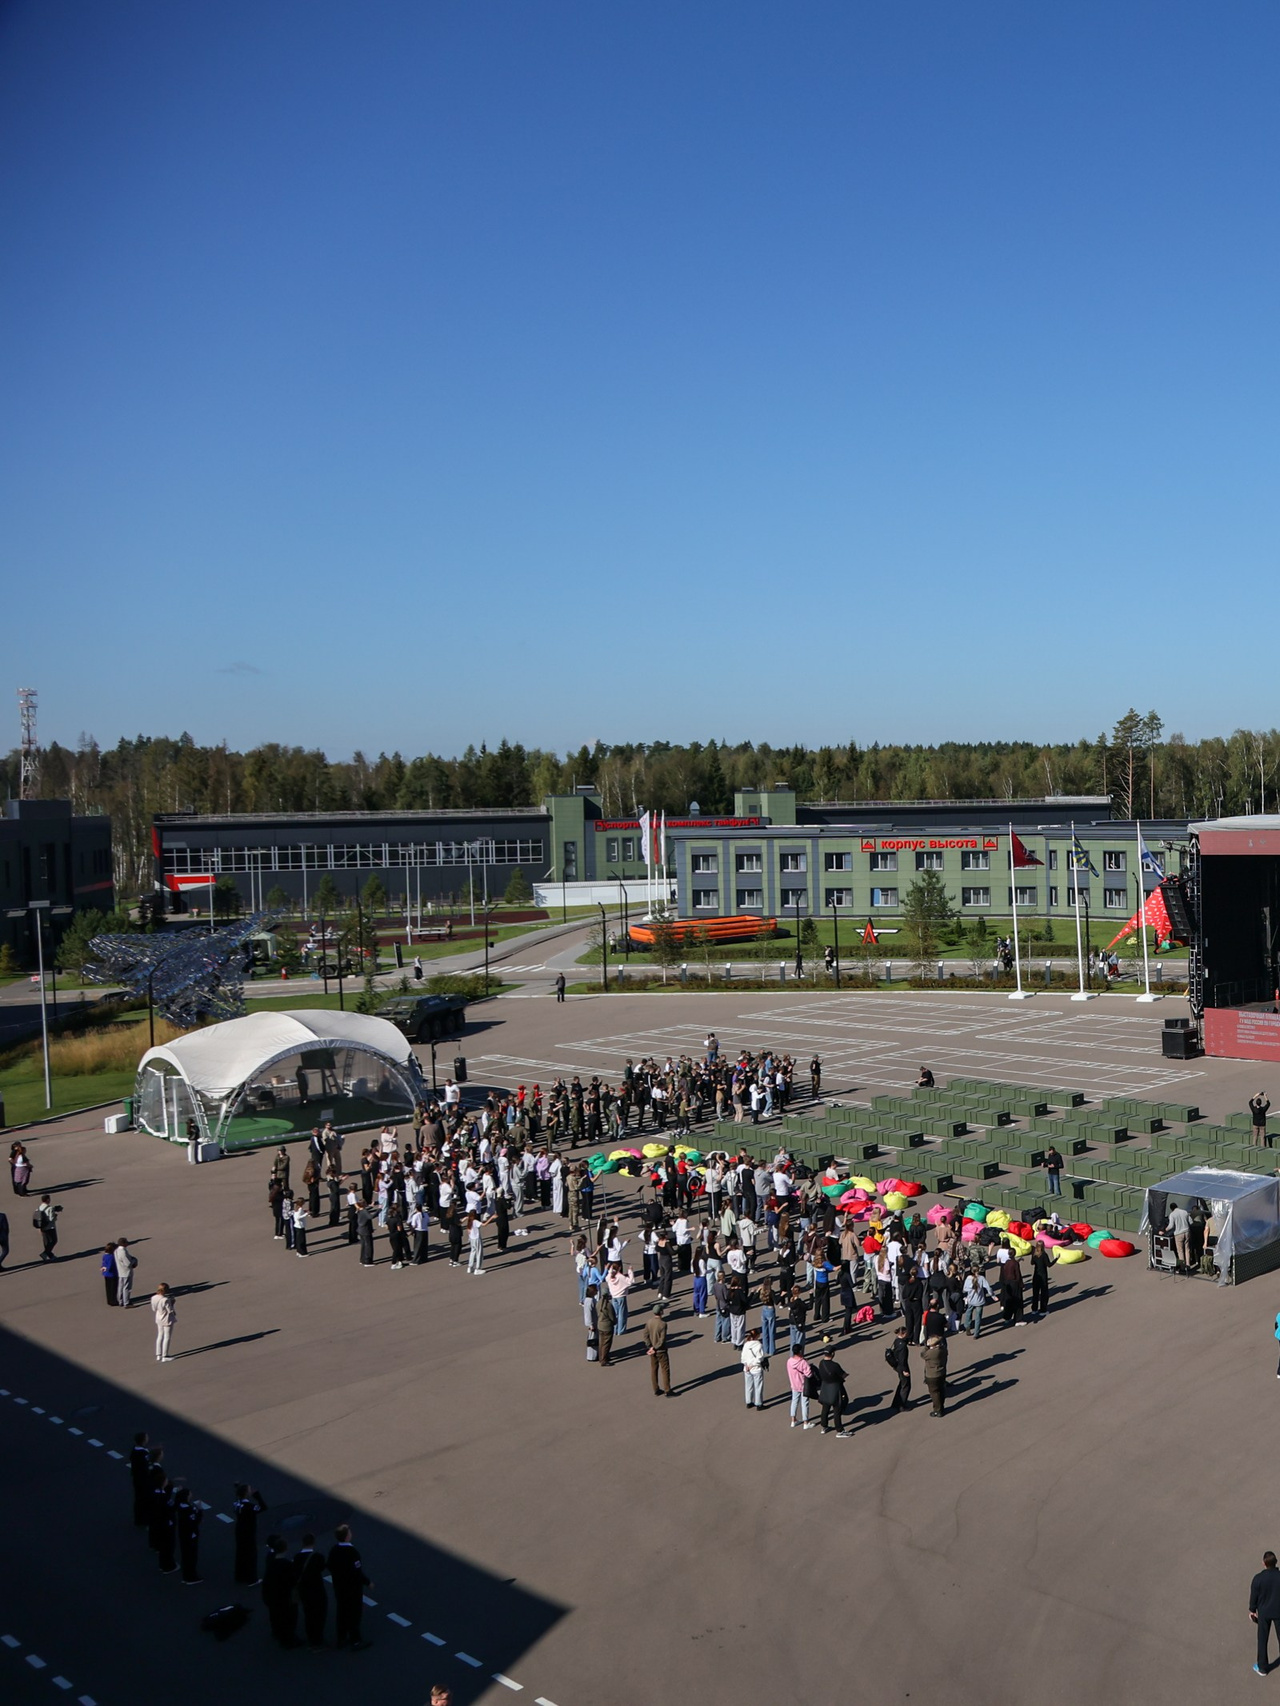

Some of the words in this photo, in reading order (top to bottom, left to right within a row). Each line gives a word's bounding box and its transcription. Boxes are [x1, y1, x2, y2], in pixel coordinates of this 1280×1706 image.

[667, 819, 712, 828] комплекс
[881, 840, 926, 851] корпус
[929, 838, 978, 849] высота
